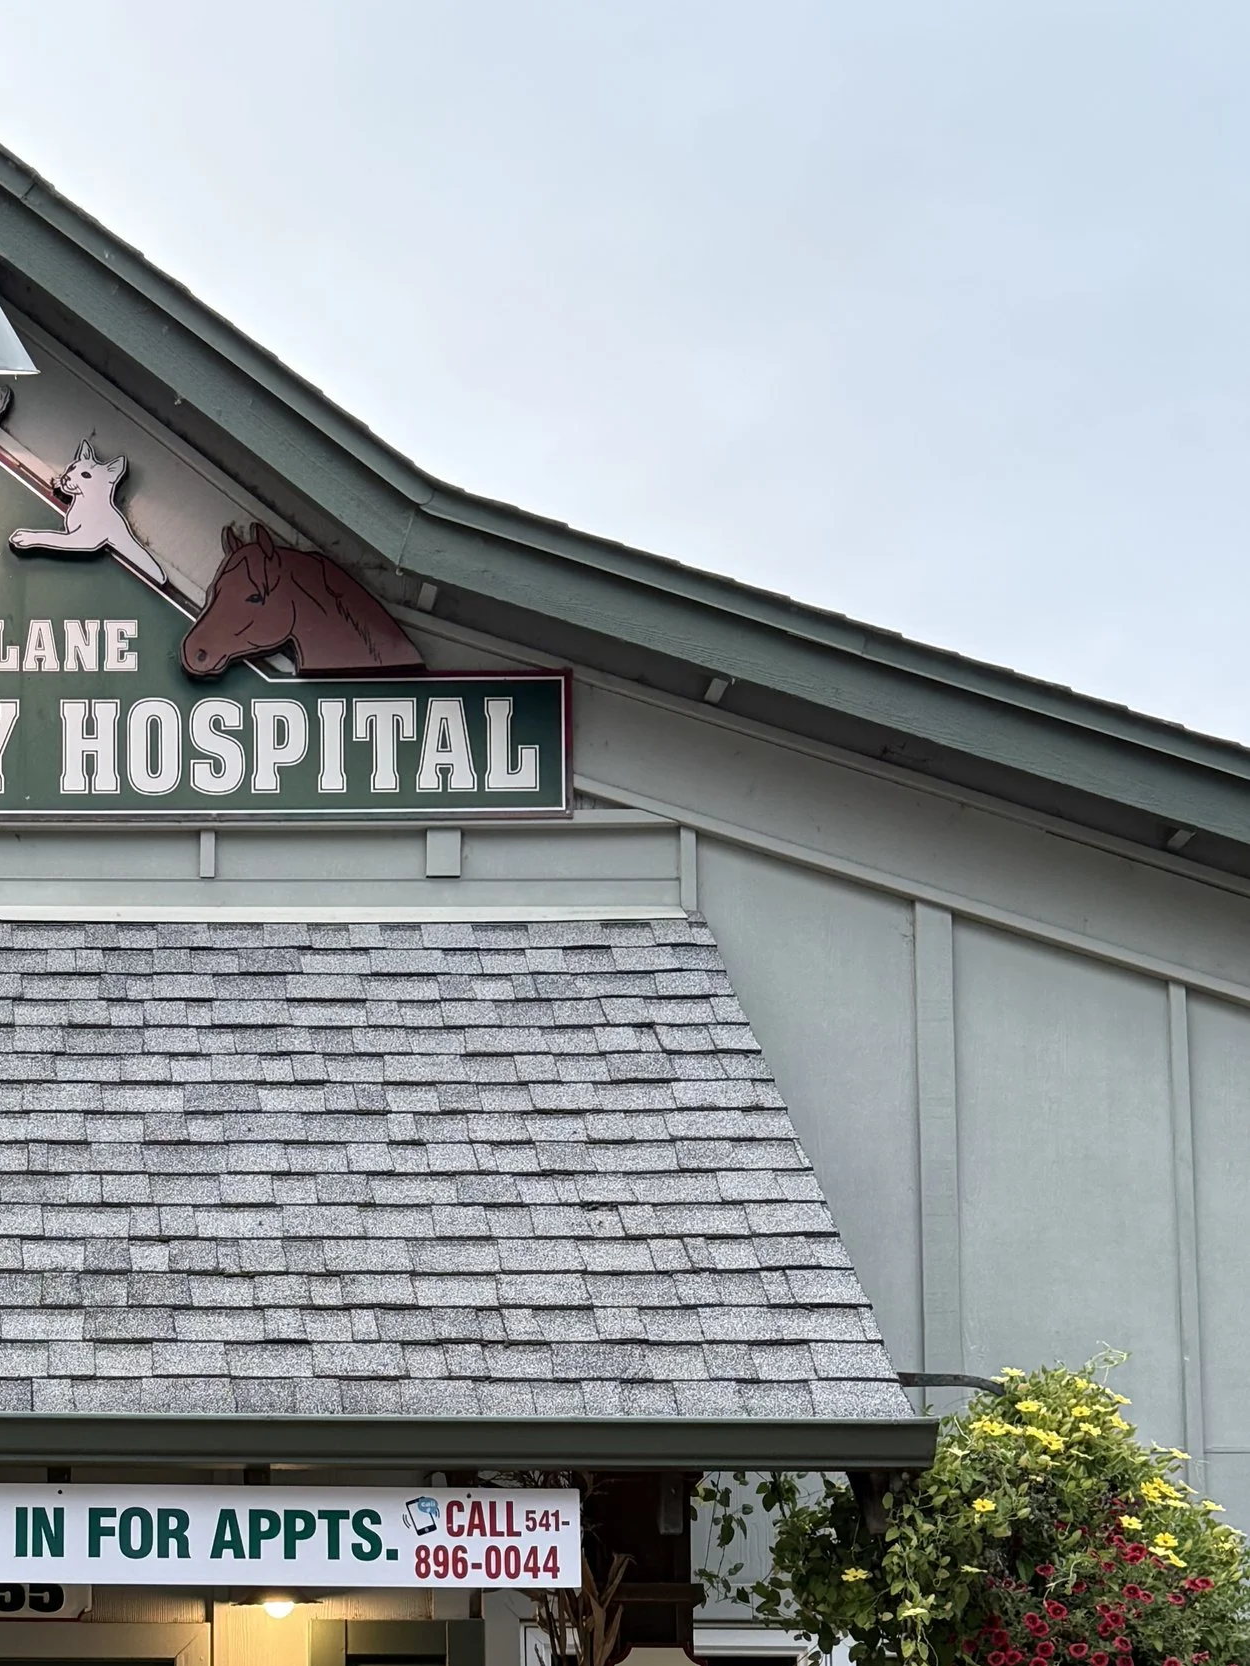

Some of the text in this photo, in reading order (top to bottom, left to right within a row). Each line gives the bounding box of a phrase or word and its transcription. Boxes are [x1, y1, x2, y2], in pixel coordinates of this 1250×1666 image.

[60, 697, 541, 794] HOSPITAL
[15, 1506, 65, 1558] IN
[87, 1507, 191, 1559] FOR
[210, 1508, 399, 1562] APPTS.
[446, 1500, 571, 1537] CALL 541-
[414, 1545, 560, 1580] 896-0044
